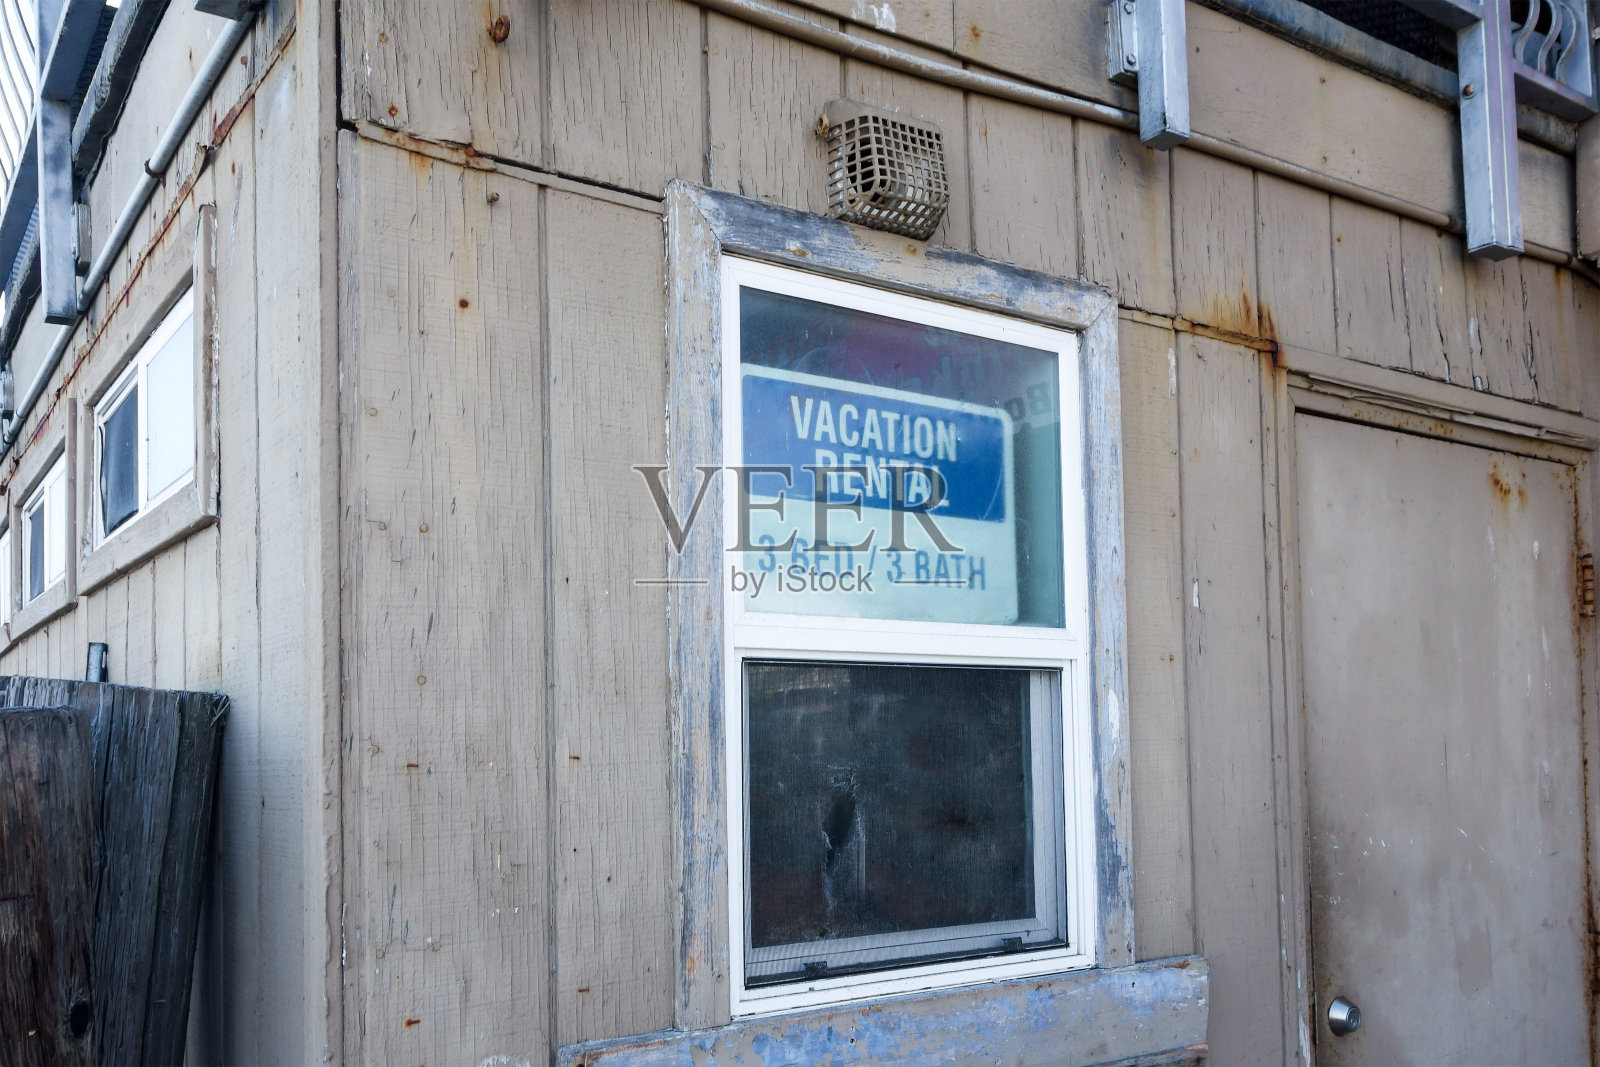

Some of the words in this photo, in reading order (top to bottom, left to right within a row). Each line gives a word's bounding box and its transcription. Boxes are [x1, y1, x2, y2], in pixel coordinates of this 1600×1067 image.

[789, 395, 958, 462] VACATION
[815, 449, 950, 507] RENTAL
[758, 534, 777, 573] 3
[791, 538, 854, 580] BED
[886, 547, 903, 584] 3
[915, 550, 986, 590] BATH
